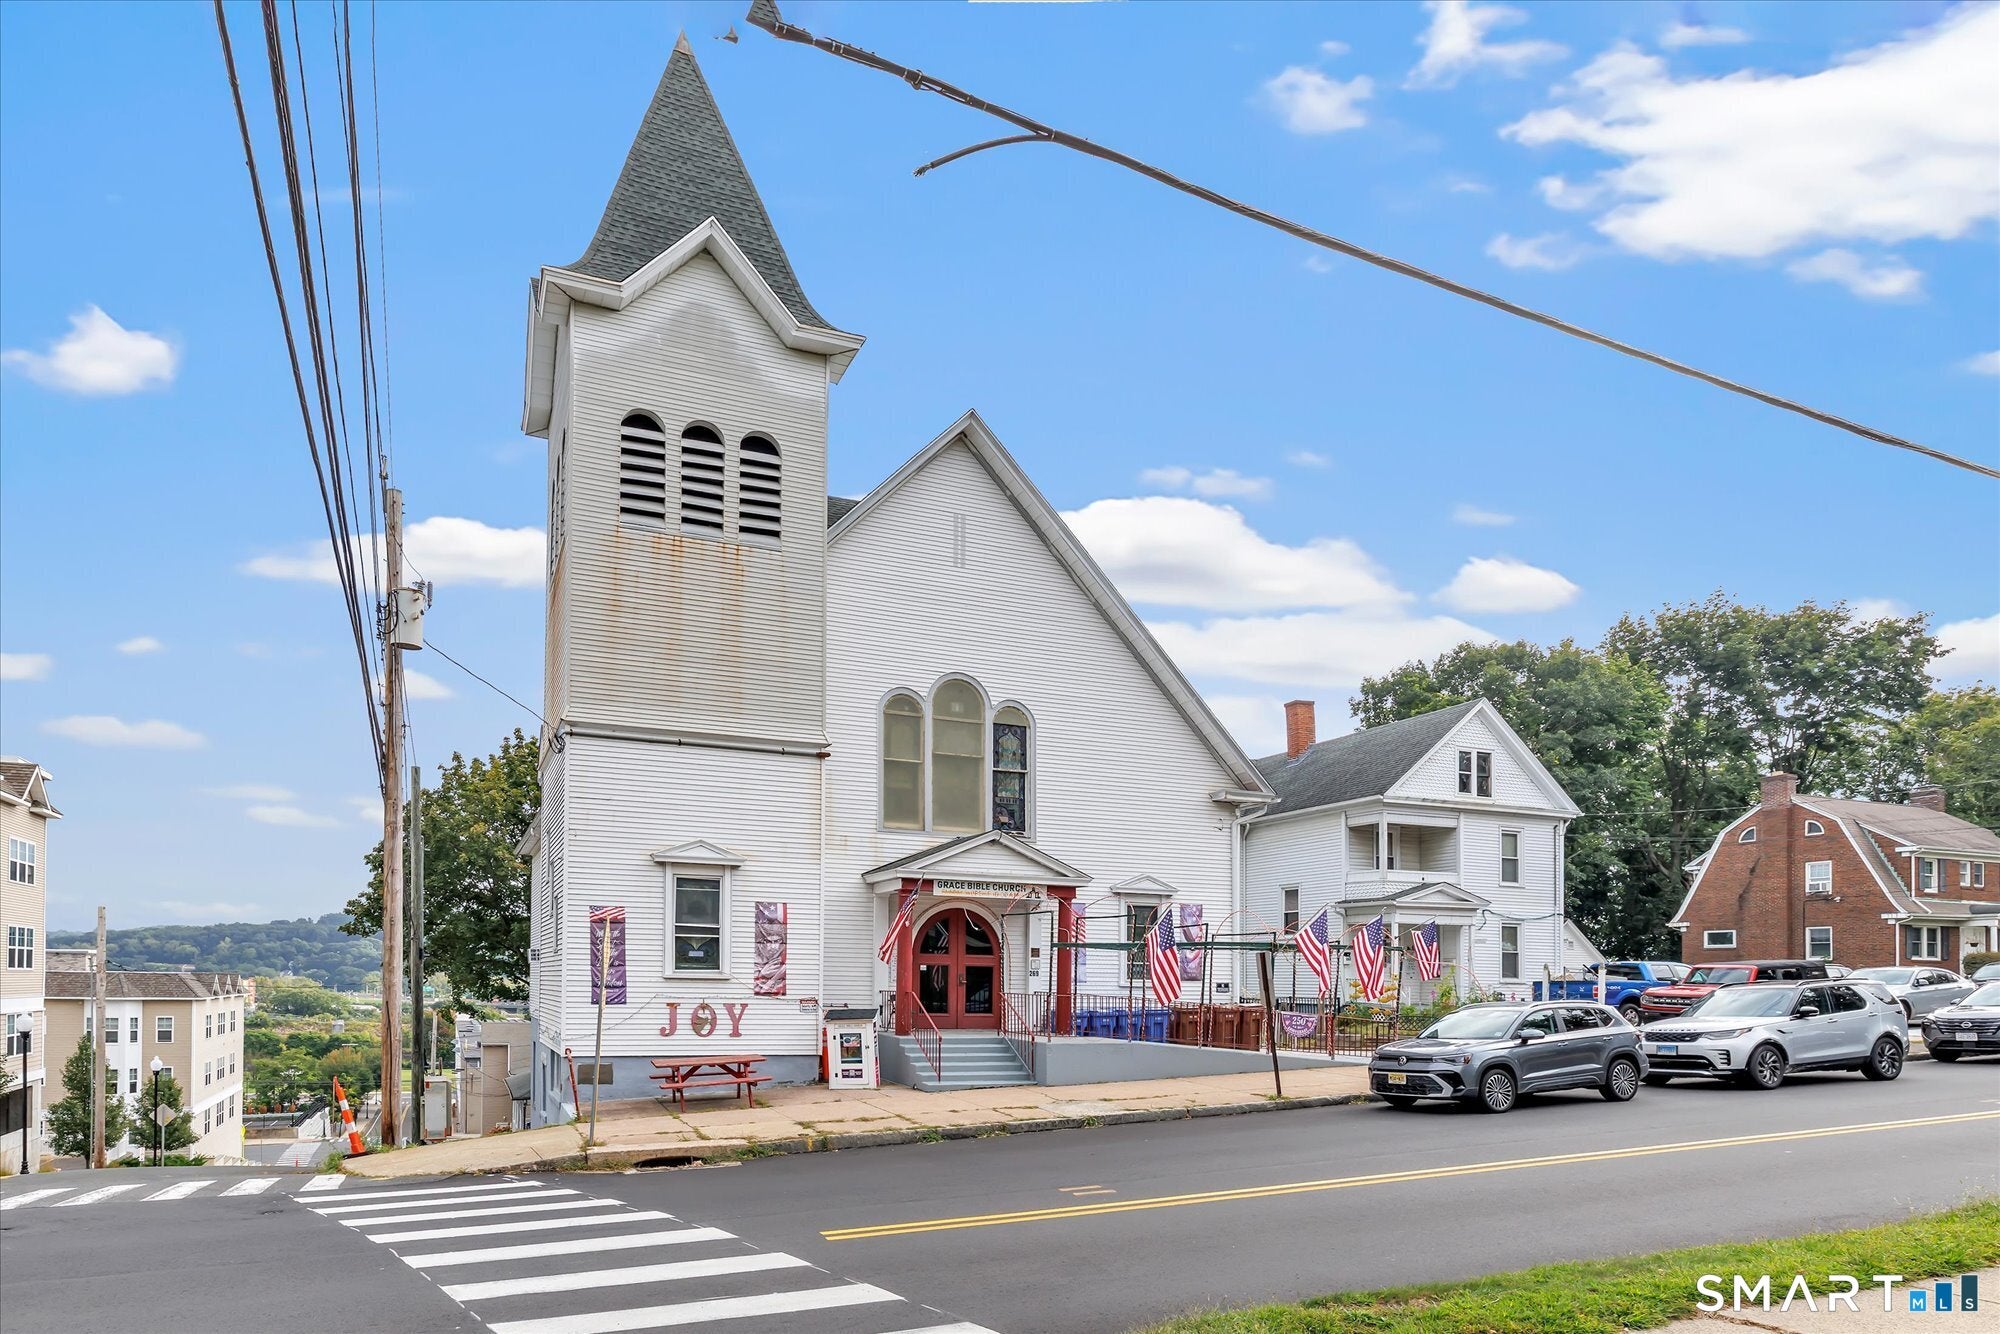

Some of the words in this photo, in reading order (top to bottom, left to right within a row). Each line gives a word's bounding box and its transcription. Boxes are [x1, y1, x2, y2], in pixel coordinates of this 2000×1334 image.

[937, 880, 966, 890] GRACE
[967, 882, 990, 891] BIBLE
[659, 1002, 749, 1038] JOY
[1292, 1016, 1306, 1026] 250
